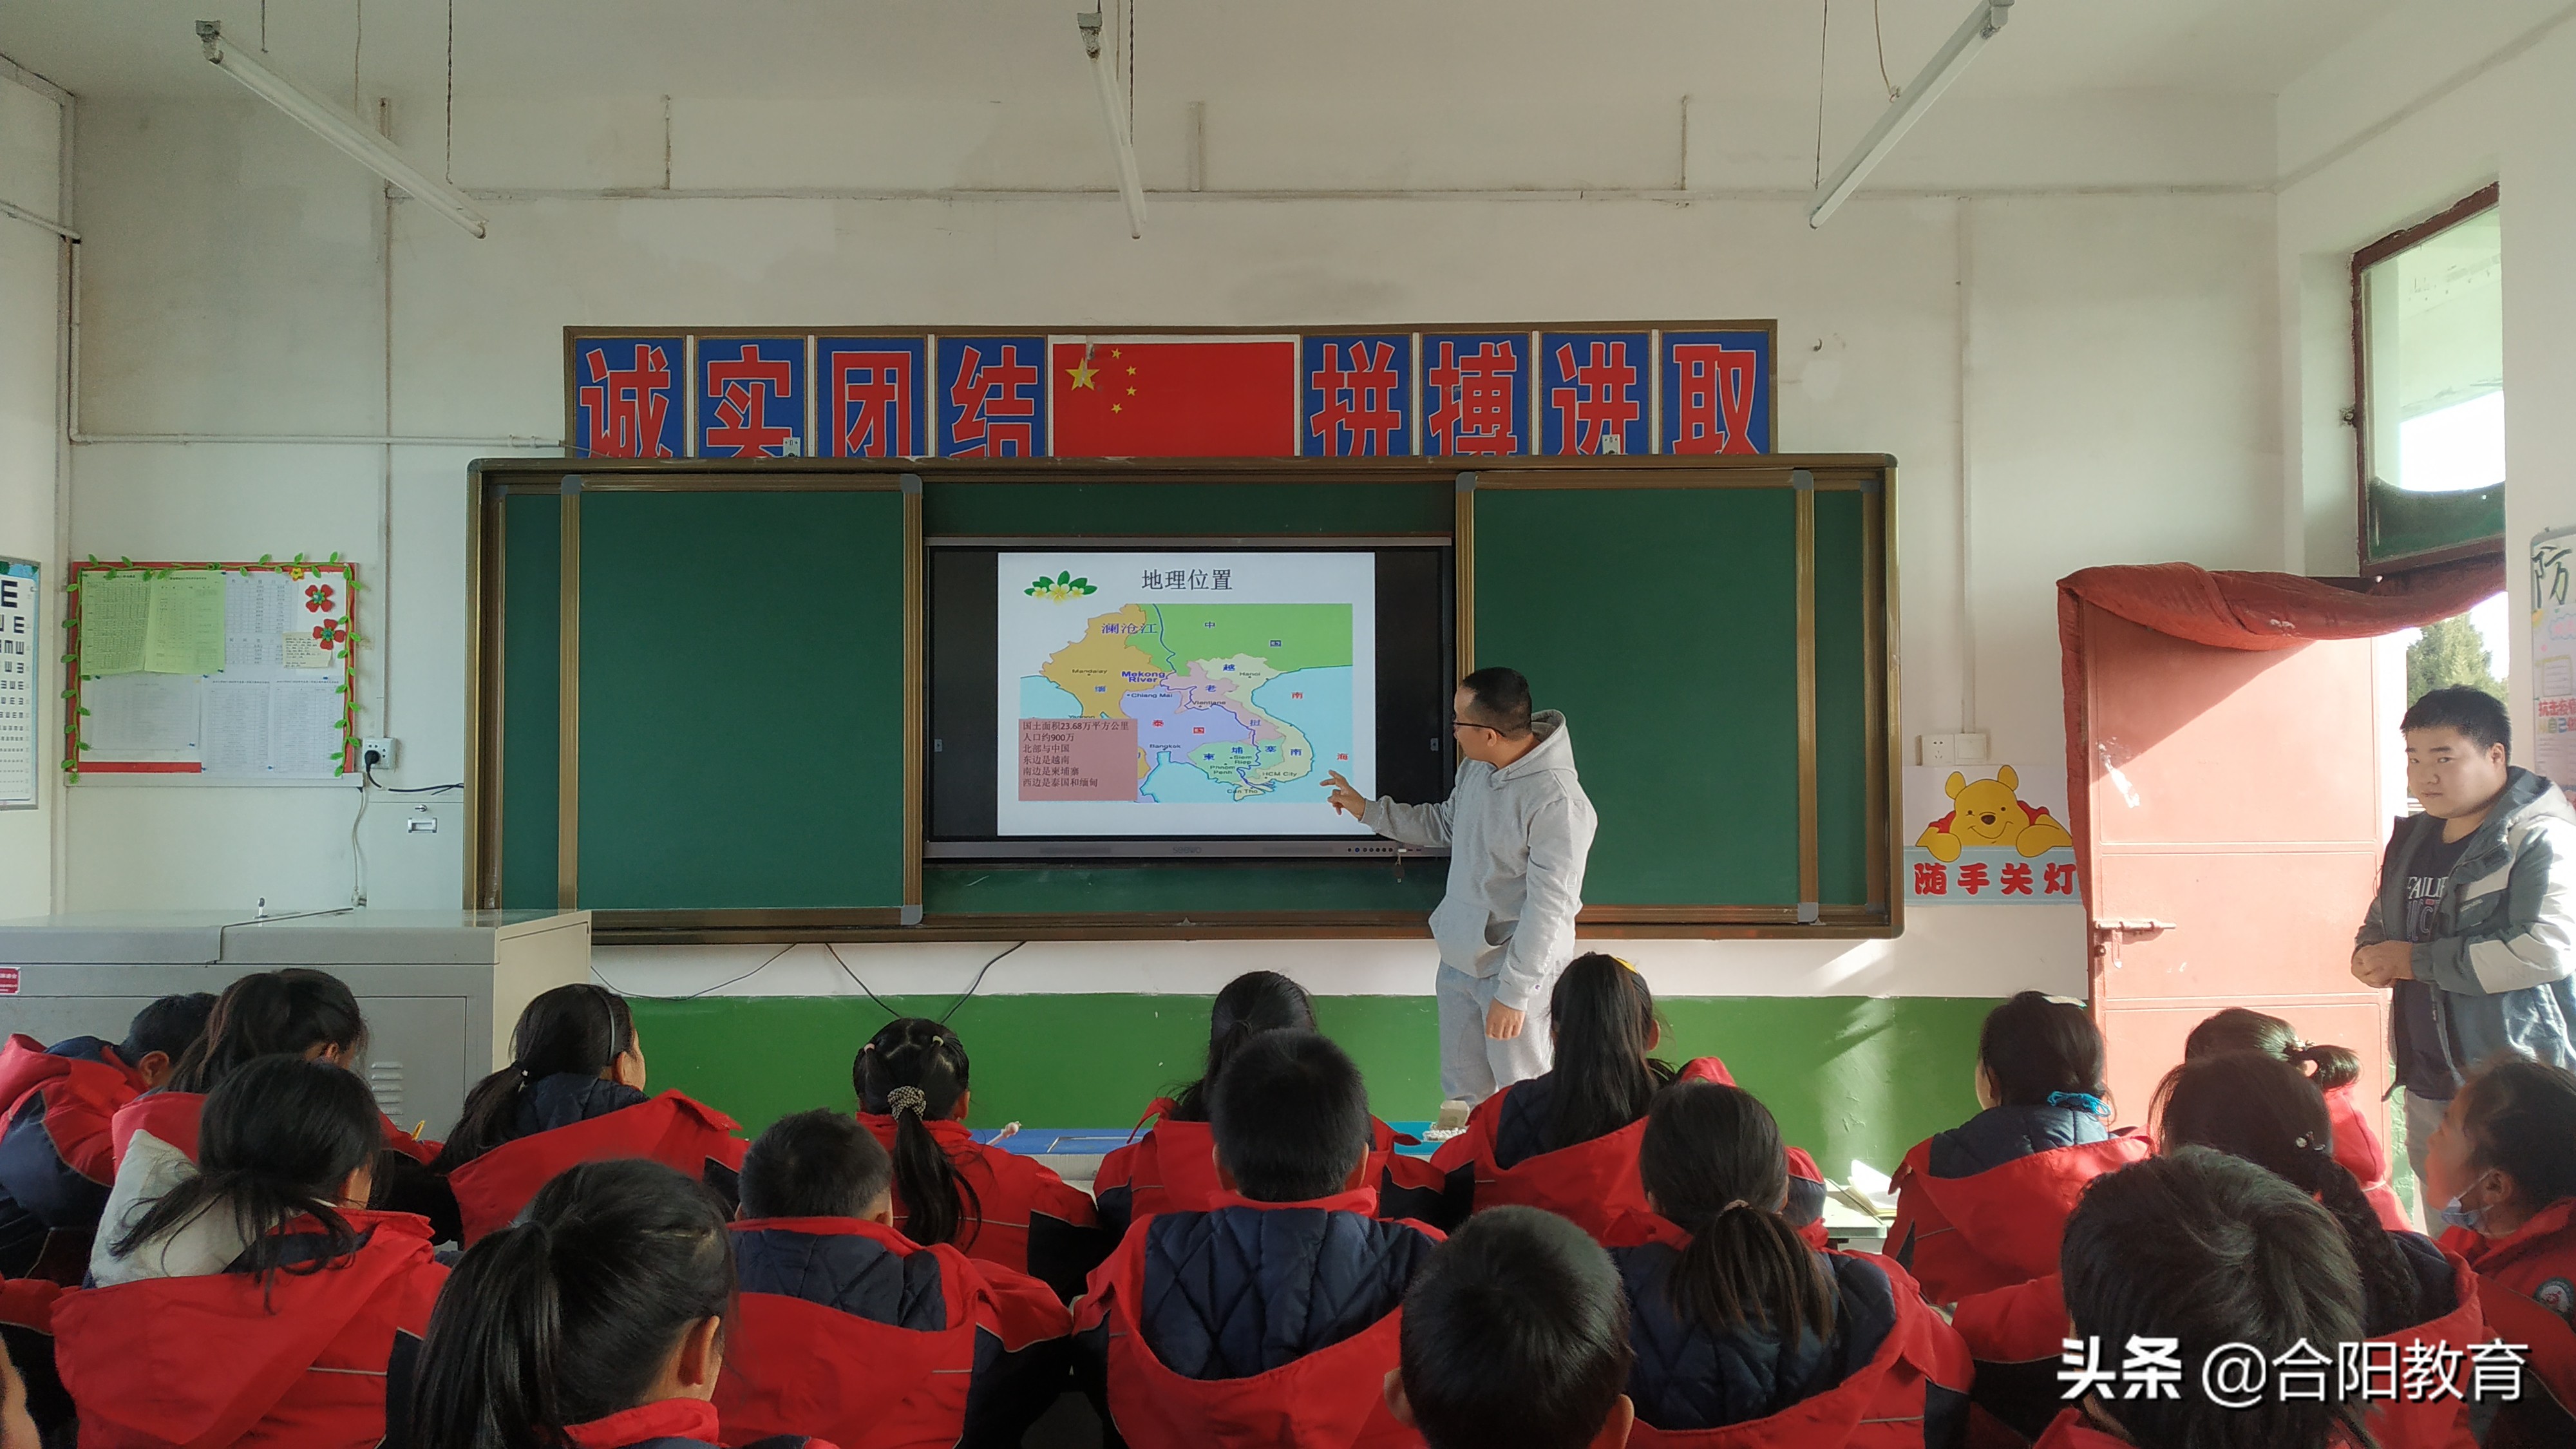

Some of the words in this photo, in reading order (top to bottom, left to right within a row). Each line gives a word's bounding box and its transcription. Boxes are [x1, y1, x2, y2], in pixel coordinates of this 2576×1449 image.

[1141, 569, 1233, 591] 地理位置
[2532, 545, 2572, 609] 防
[1101, 623, 1158, 634] 澜沧江
[1122, 671, 1166, 679] Mekong
[1023, 721, 1129, 731] 国土面积23.68万平方公里
[1023, 732, 1074, 742] 人口约900万
[1023, 744, 1070, 753] 北部与中国
[1023, 755, 1070, 764] 东边是越南
[1023, 766, 1079, 776] 南边是柬埔寨
[1023, 777, 1098, 787] 西边是泰国和缅甸
[1914, 862, 2076, 895] 随手关灯
